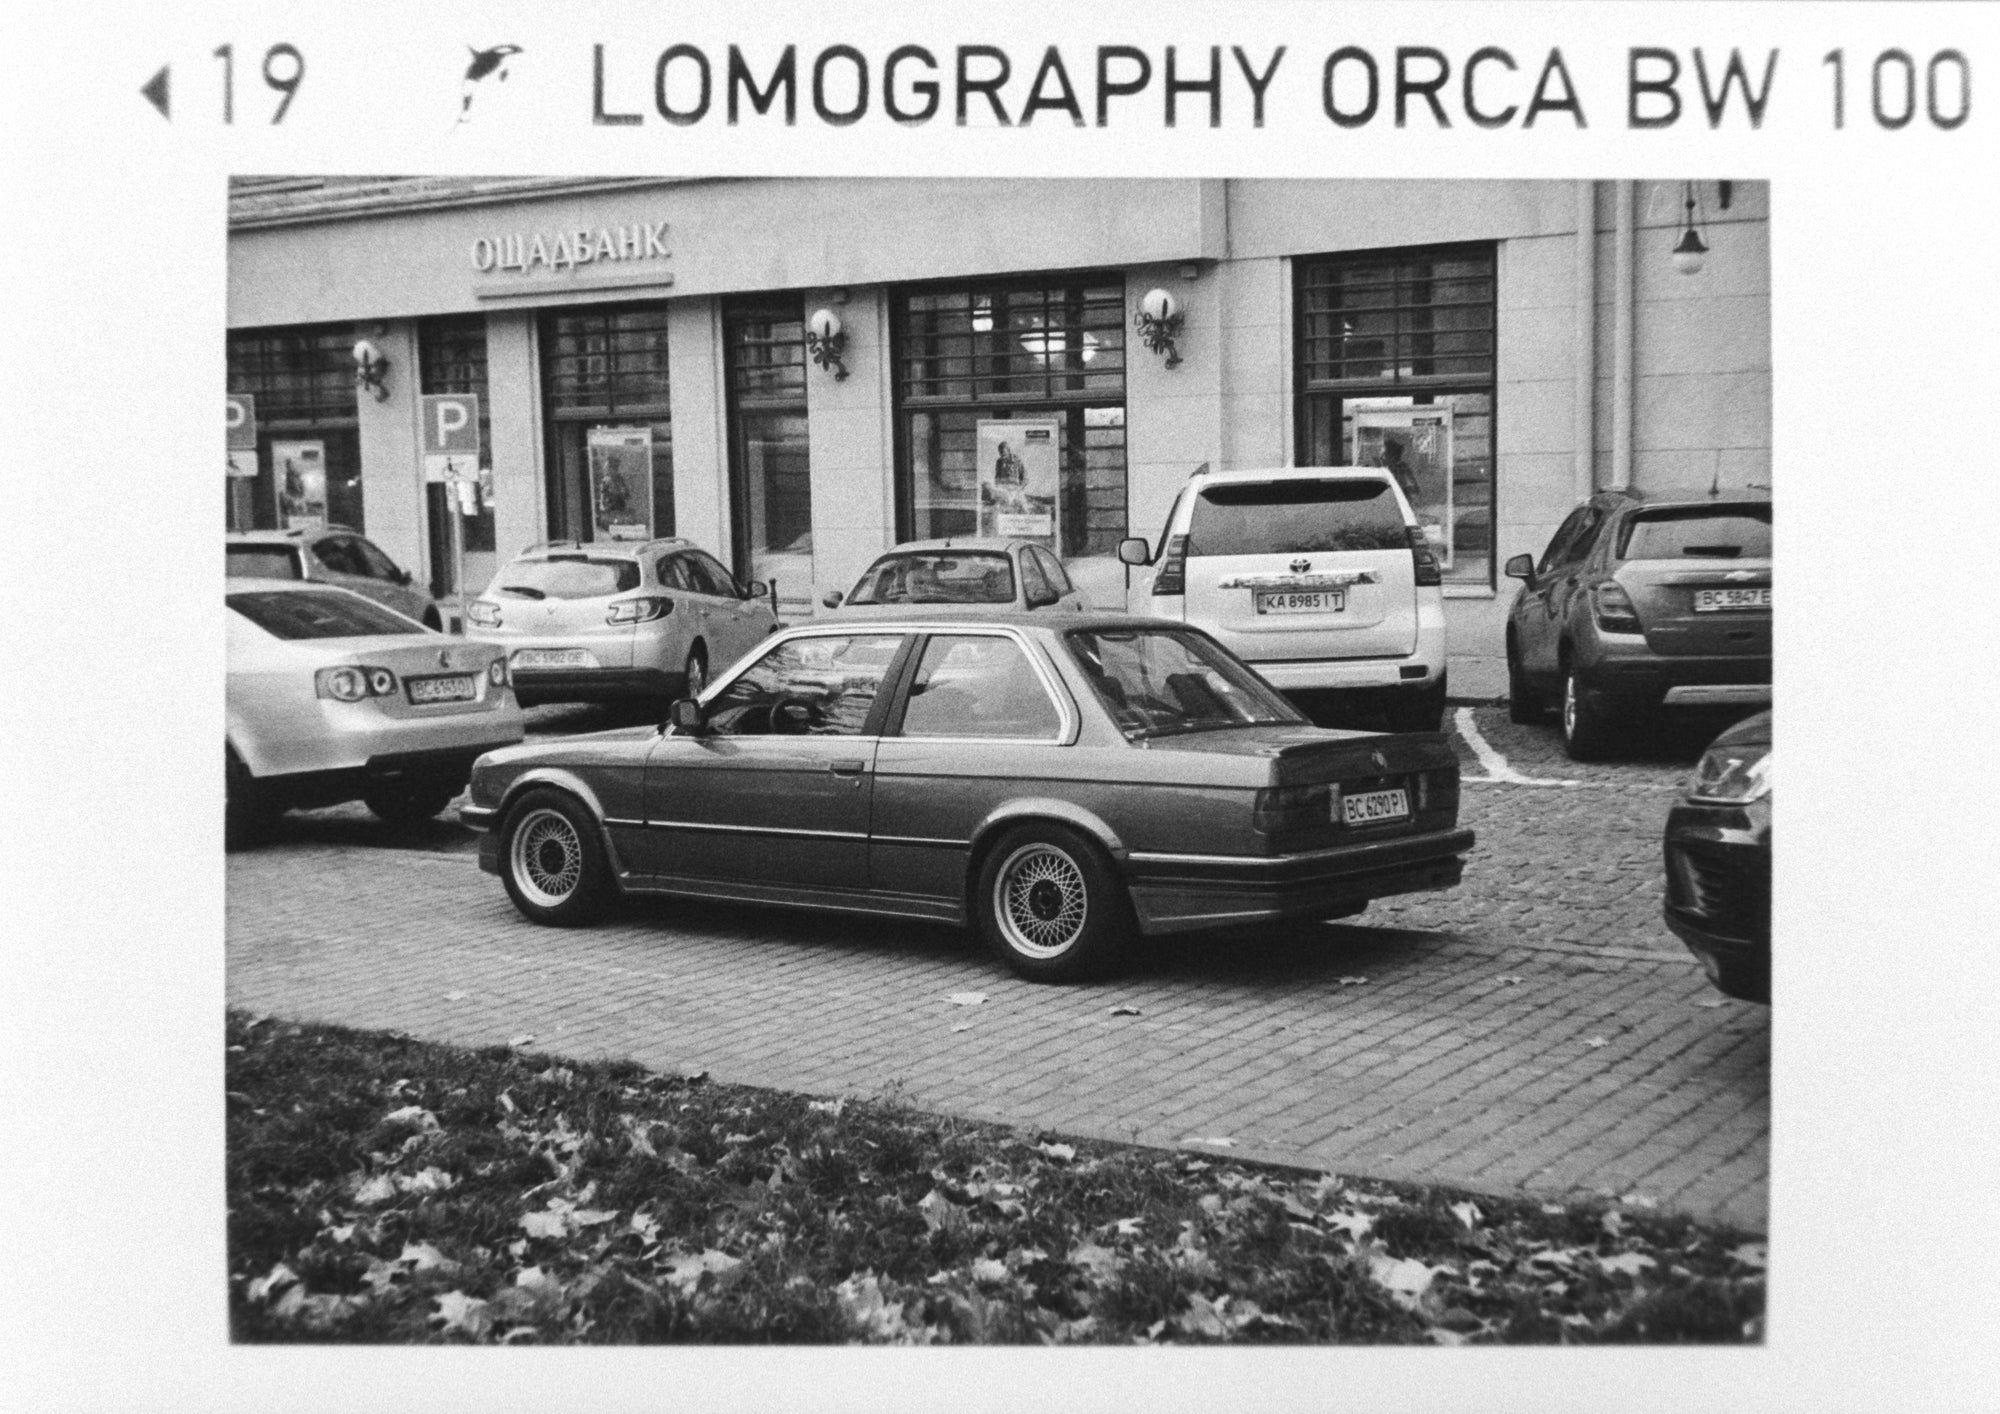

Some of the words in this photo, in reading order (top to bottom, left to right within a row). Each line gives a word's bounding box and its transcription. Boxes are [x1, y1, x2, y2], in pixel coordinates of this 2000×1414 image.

[472, 221, 671, 273] ОЩАДБАНК
[437, 401, 467, 447] P
[1266, 595, 1286, 609] KA
[1289, 594, 1321, 608] 8985
[1325, 593, 1341, 607] IT
[1703, 591, 1722, 605] BC
[1346, 797, 1365, 820] BC
[1366, 794, 1391, 817] 6290
